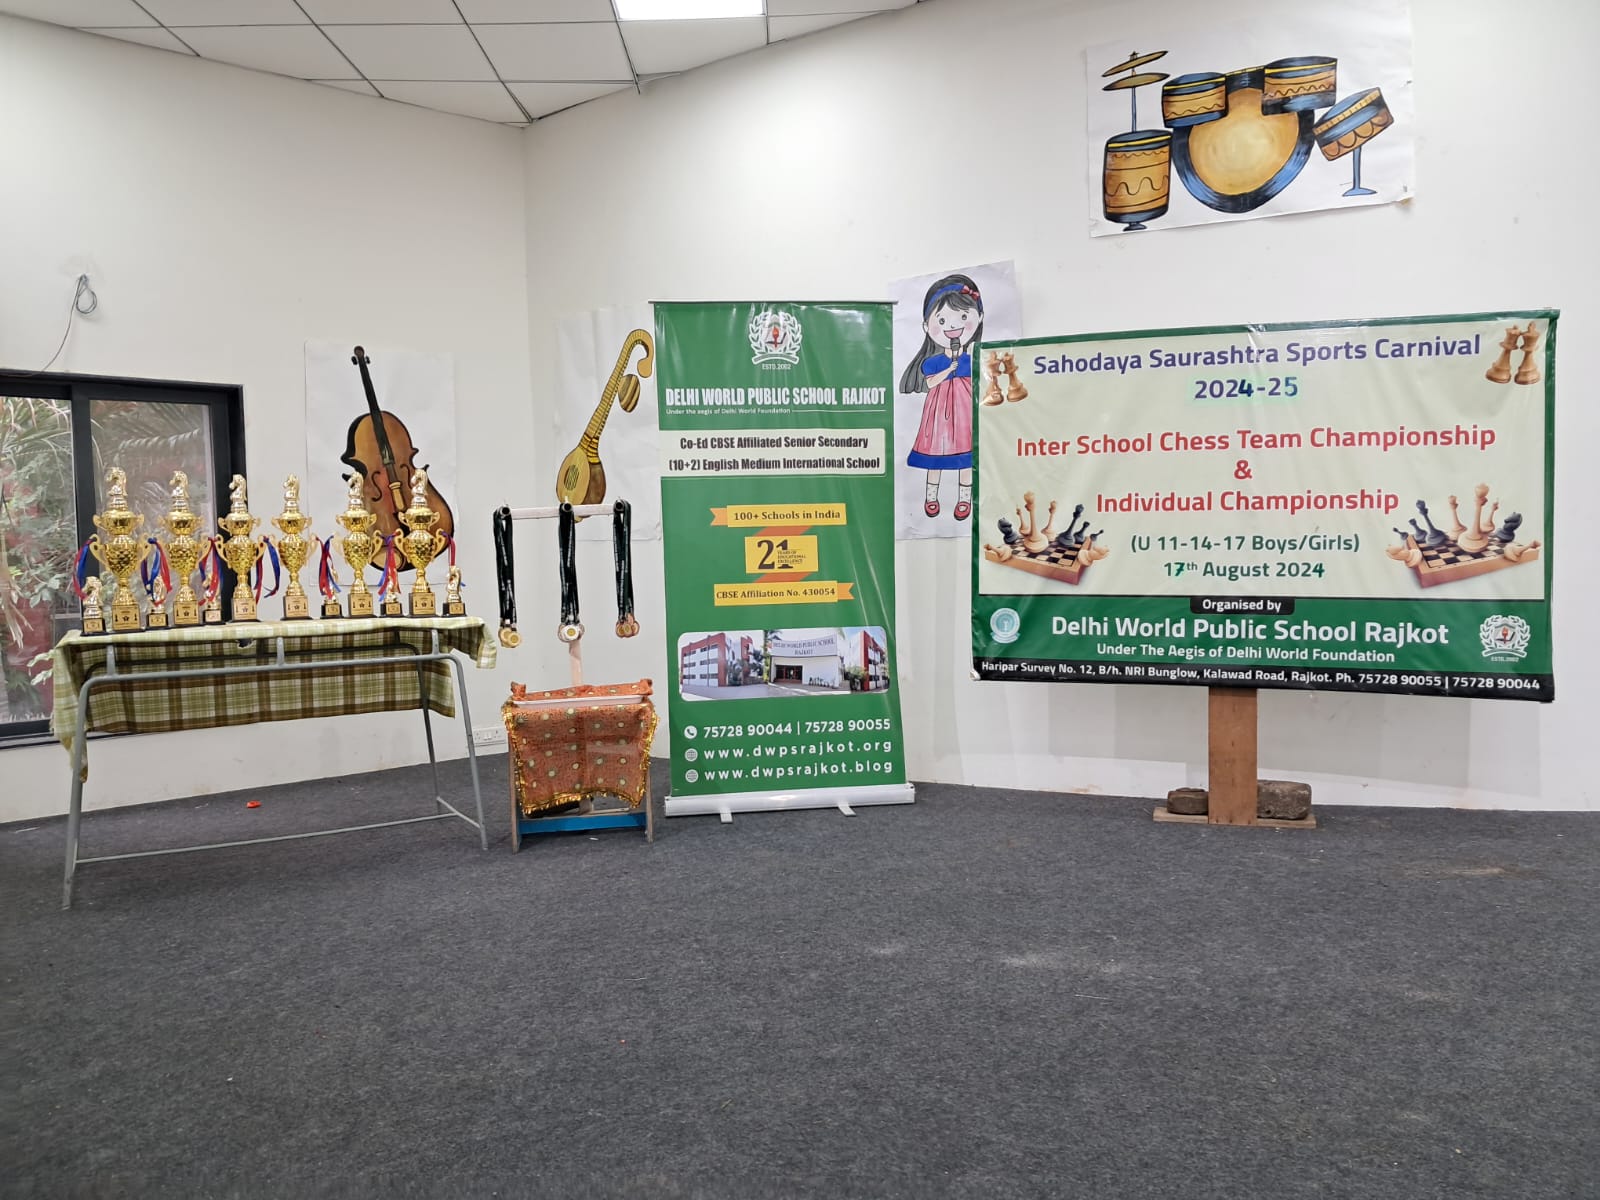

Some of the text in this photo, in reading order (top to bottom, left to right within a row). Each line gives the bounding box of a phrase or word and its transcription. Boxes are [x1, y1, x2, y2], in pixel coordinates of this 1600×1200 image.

[1034, 334, 1481, 375] Sahodaya Saurashtra Sports Carnival
[665, 387, 887, 406] DELHI WORLD PUBLIC SCHOOL RAJKOT
[1194, 376, 1298, 400] 2024-25
[680, 435, 868, 450] Co-Ed CBSE Affiliated Senior Secondary
[1017, 425, 1496, 456] Inter School Chess Team Championship
[669, 457, 880, 471] (10+2) English Medium International School
[1234, 460, 1252, 479] &
[1097, 489, 1400, 515] Individual Championship
[734, 510, 841, 521] 100+ Schools in India
[1131, 533, 1360, 555] (U 11-14-17 Boys/Girls)
[757, 539, 794, 570] 21
[1164, 561, 1325, 581] 17th August 2024
[716, 587, 836, 599] CBSE Affiliation No. 430054
[1203, 599, 1281, 613] Organised by
[1052, 616, 1449, 648] Delhi World Public School Rajkot
[1097, 643, 1395, 662] Under The Aegis of Delhi World Foundation
[981, 661, 1018, 673] Haripar
[1020, 663, 1056, 675] Survey
[1059, 664, 1077, 674] No.
[1079, 665, 1096, 676] 12,
[1099, 665, 1122, 675] B/h.
[1125, 666, 1145, 676] NRI
[1148, 667, 1200, 680] Bunglow,
[1203, 668, 1252, 680] Kalawad
[1255, 670, 1288, 682] Road,
[1291, 672, 1333, 684] Rajkot.
[1336, 673, 1355, 683] Ph.
[1358, 674, 1398, 685] 75728
[1400, 675, 1441, 686] 90055
[1453, 676, 1493, 688] 75728
[1497, 678, 1540, 689] 90044
[703, 726, 743, 738] 75728
[747, 722, 792, 735] 90044
[805, 720, 844, 733] 75728
[848, 719, 891, 731] 90055
